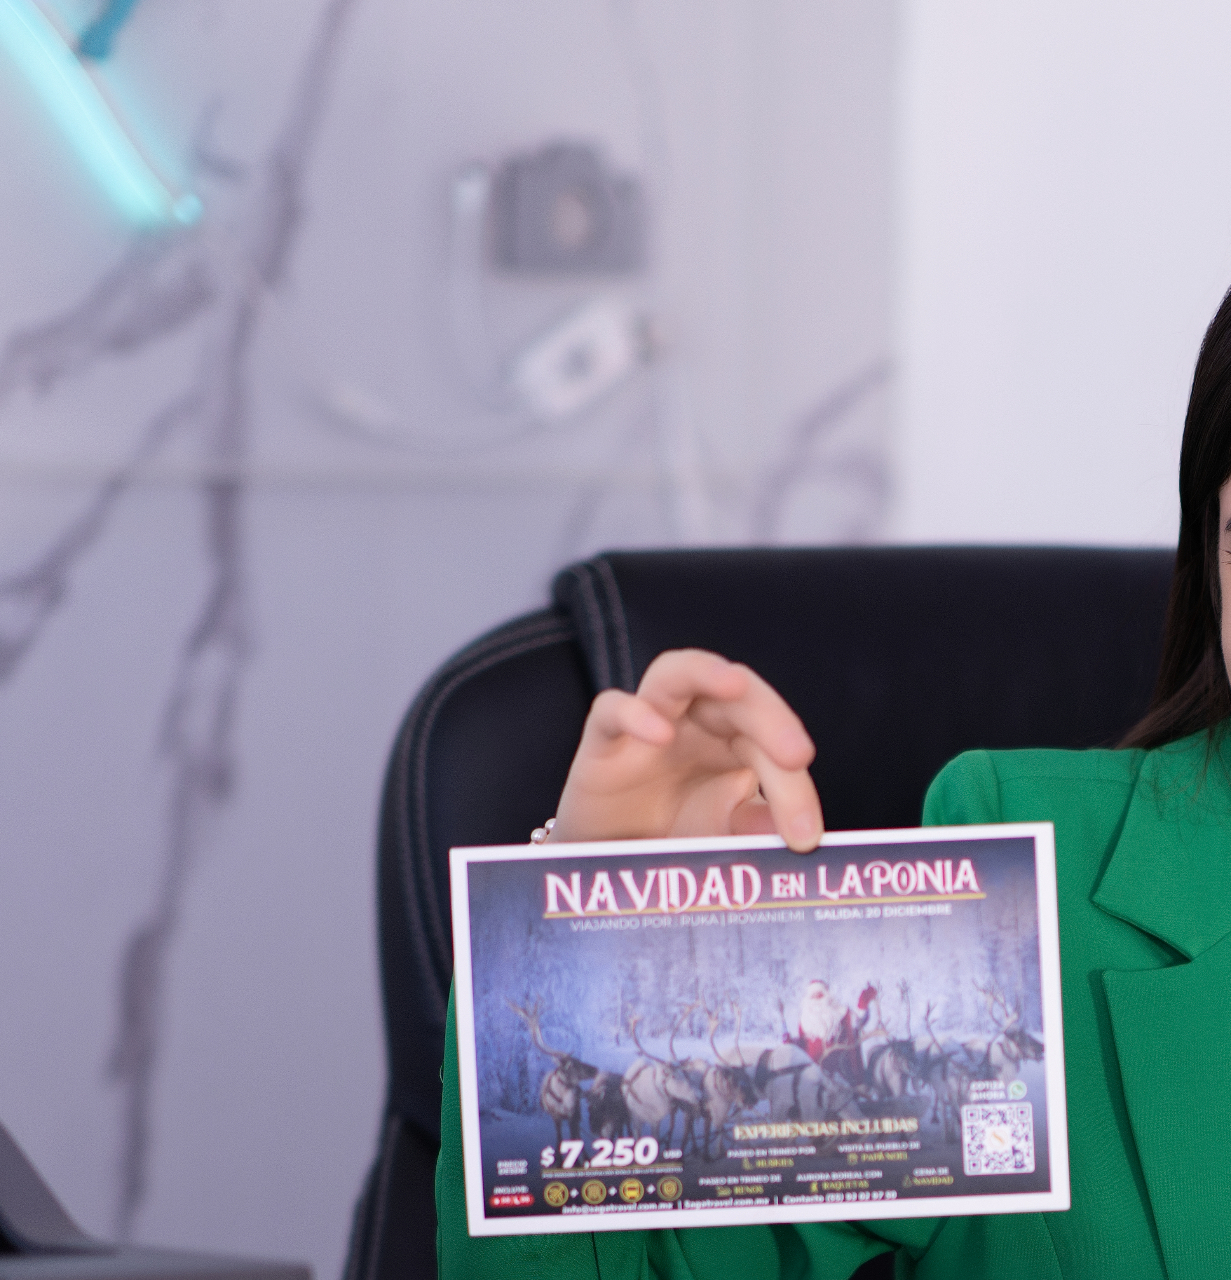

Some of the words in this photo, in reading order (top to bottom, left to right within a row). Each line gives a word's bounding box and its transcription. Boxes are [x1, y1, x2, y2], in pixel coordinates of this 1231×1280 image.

[544, 863, 762, 916] NAVIDAD
[771, 872, 807, 899] EN
[817, 858, 981, 900] LAPONIA
[569, 917, 640, 932] VIAJANDO
[642, 915, 672, 929] POR
[681, 913, 719, 928] RUKA
[727, 910, 805, 926] ROVANIEMI
[865, 906, 881, 919] 20
[882, 903, 953, 918] DICIEMBRE
[733, 1121, 839, 1140] EXPERIENCIAS
[840, 1117, 919, 1136] INCLUIDAS
[540, 1145, 556, 1168] $
[559, 1136, 659, 1170] 7,250
